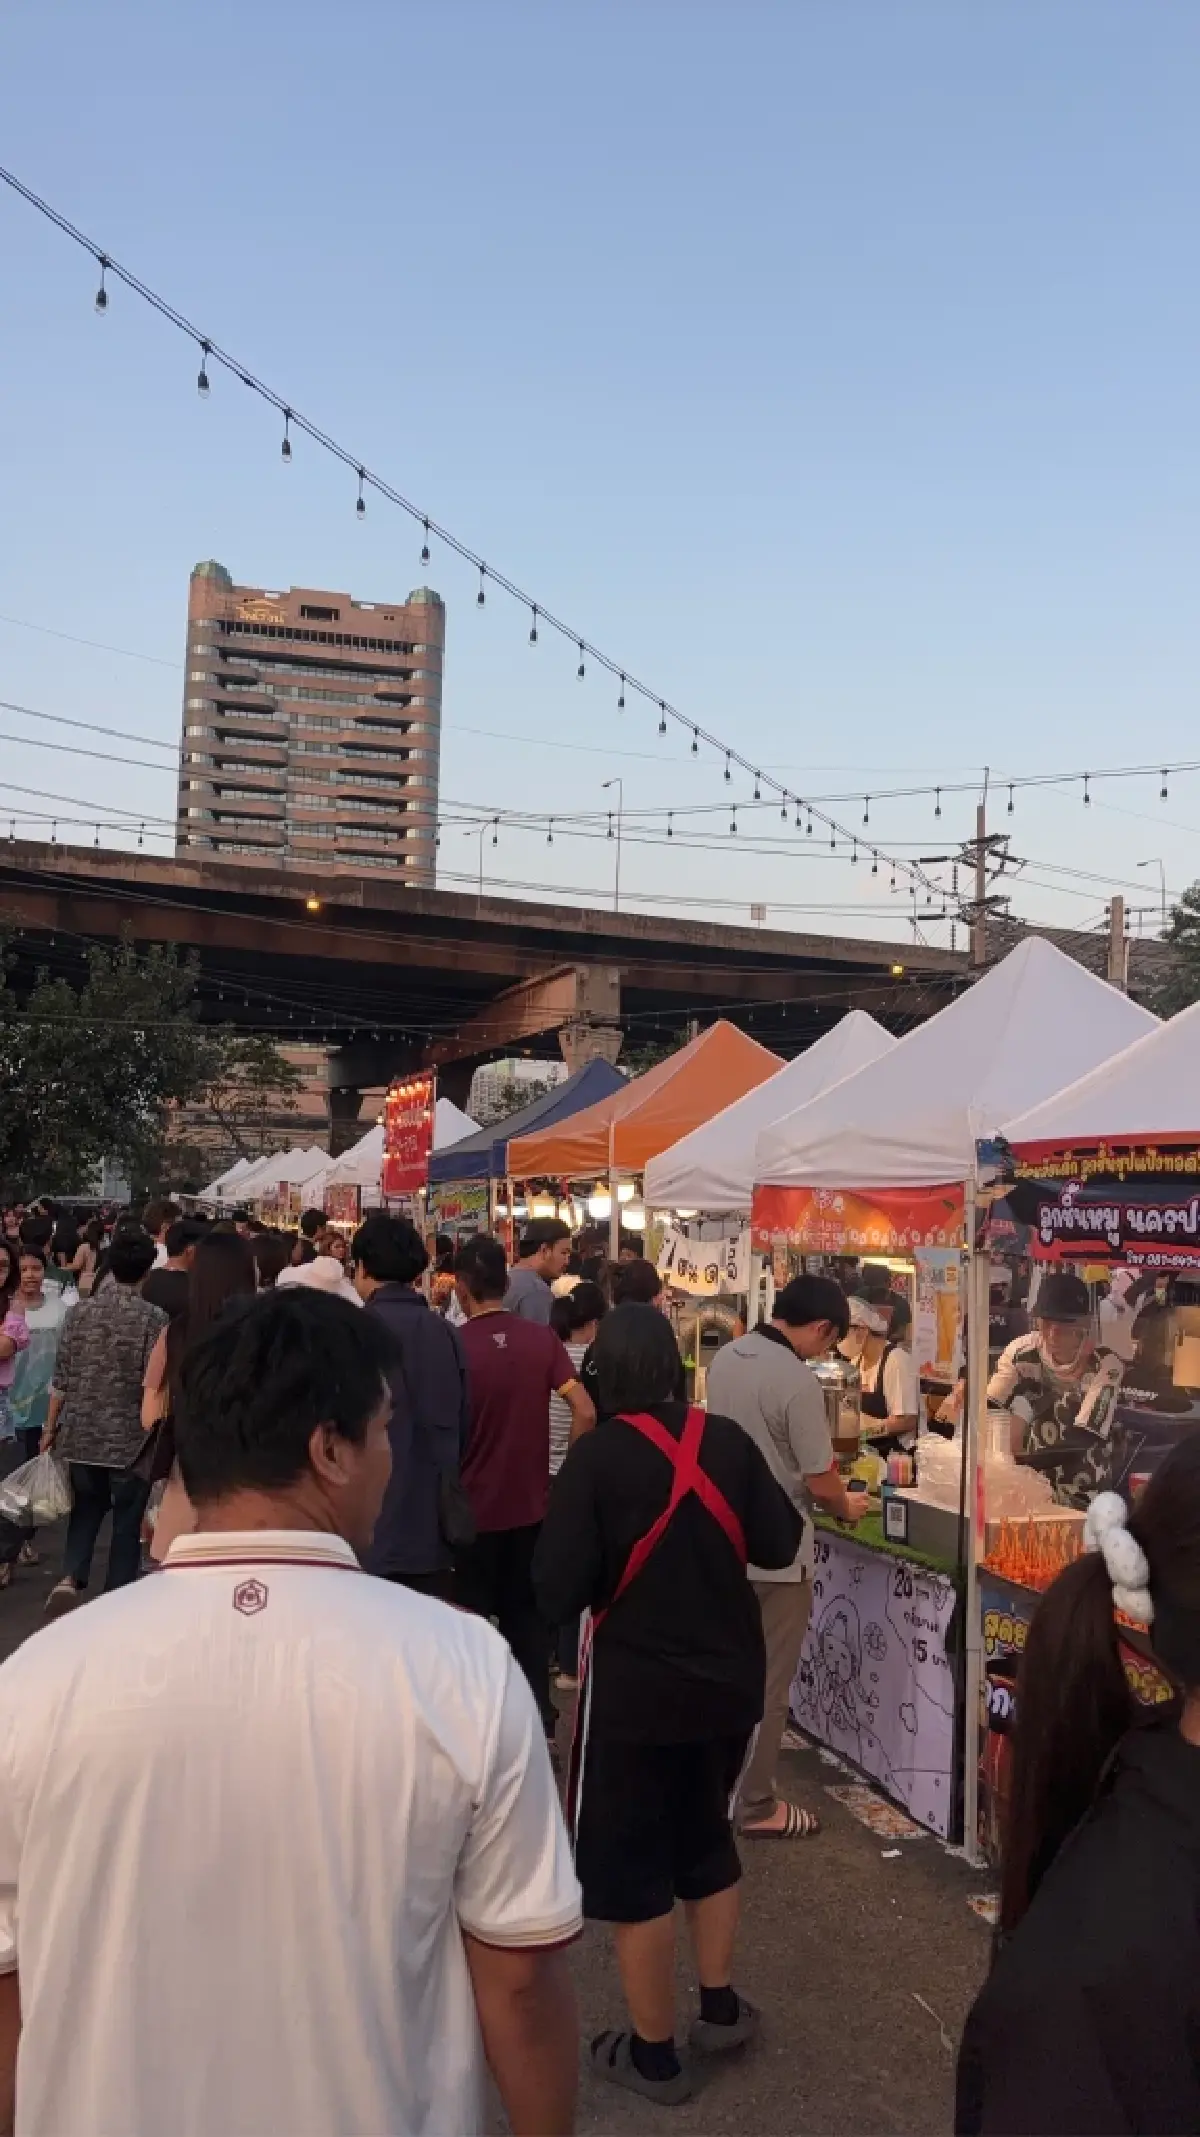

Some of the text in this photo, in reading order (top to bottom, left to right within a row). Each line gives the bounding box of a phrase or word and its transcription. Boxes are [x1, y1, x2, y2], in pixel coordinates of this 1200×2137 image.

[1041, 1183, 1200, 1247] ลูกชิ้นหมู นครป
[912, 1636, 928, 1663] 15
